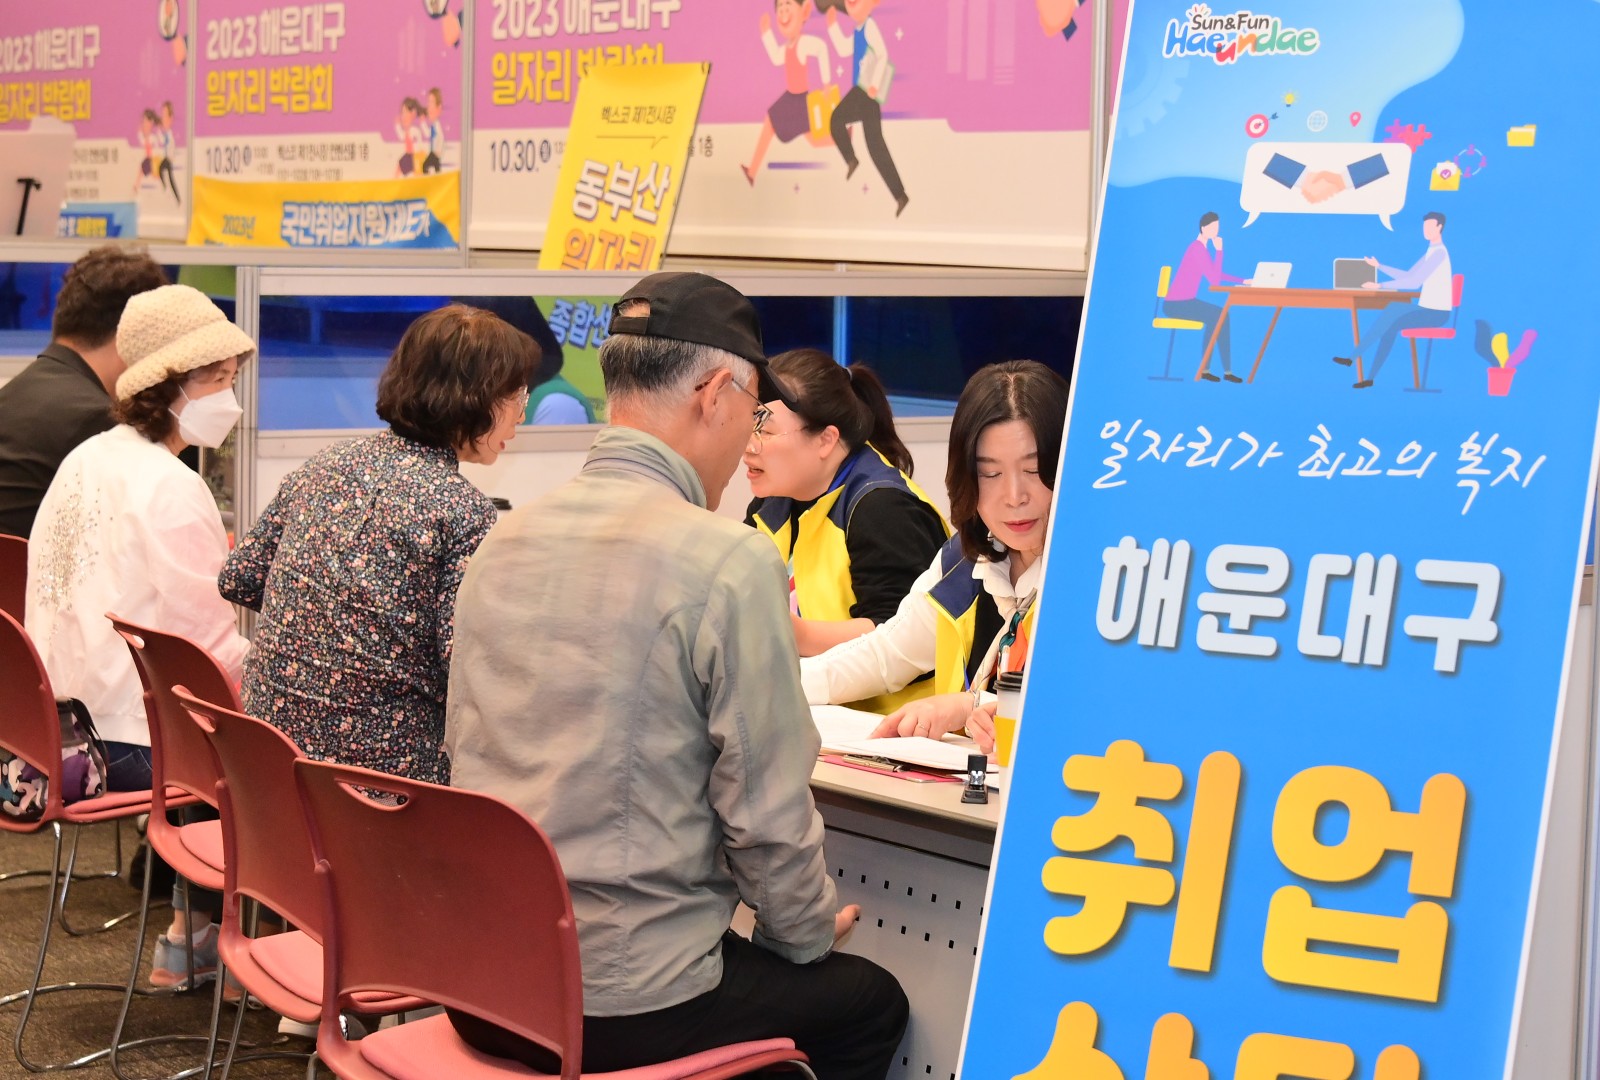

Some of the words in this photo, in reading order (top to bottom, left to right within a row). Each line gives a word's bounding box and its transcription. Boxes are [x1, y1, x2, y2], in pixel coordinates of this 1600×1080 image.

[207, 16, 257, 60] 2023
[260, 2, 345, 57] 해운대구
[491, 0, 559, 40] 2023
[1164, 20, 1318, 63] Haeundae
[1191, 13, 1270, 31] Sun&Fun
[35, 25, 101, 71] 해운대구
[207, 67, 265, 117] 일자리
[270, 63, 333, 113] 박람회
[491, 49, 571, 106] 일자리
[601, 105, 631, 124] 벡스코
[699, 135, 714, 158] 1층
[572, 159, 671, 225] 동부산
[1092, 418, 1284, 489] 일자리가
[1298, 423, 1437, 480] 최고의
[1455, 431, 1547, 515] 복지
[1095, 535, 1503, 673] 해운대구
[1041, 739, 1467, 1003] 취업
